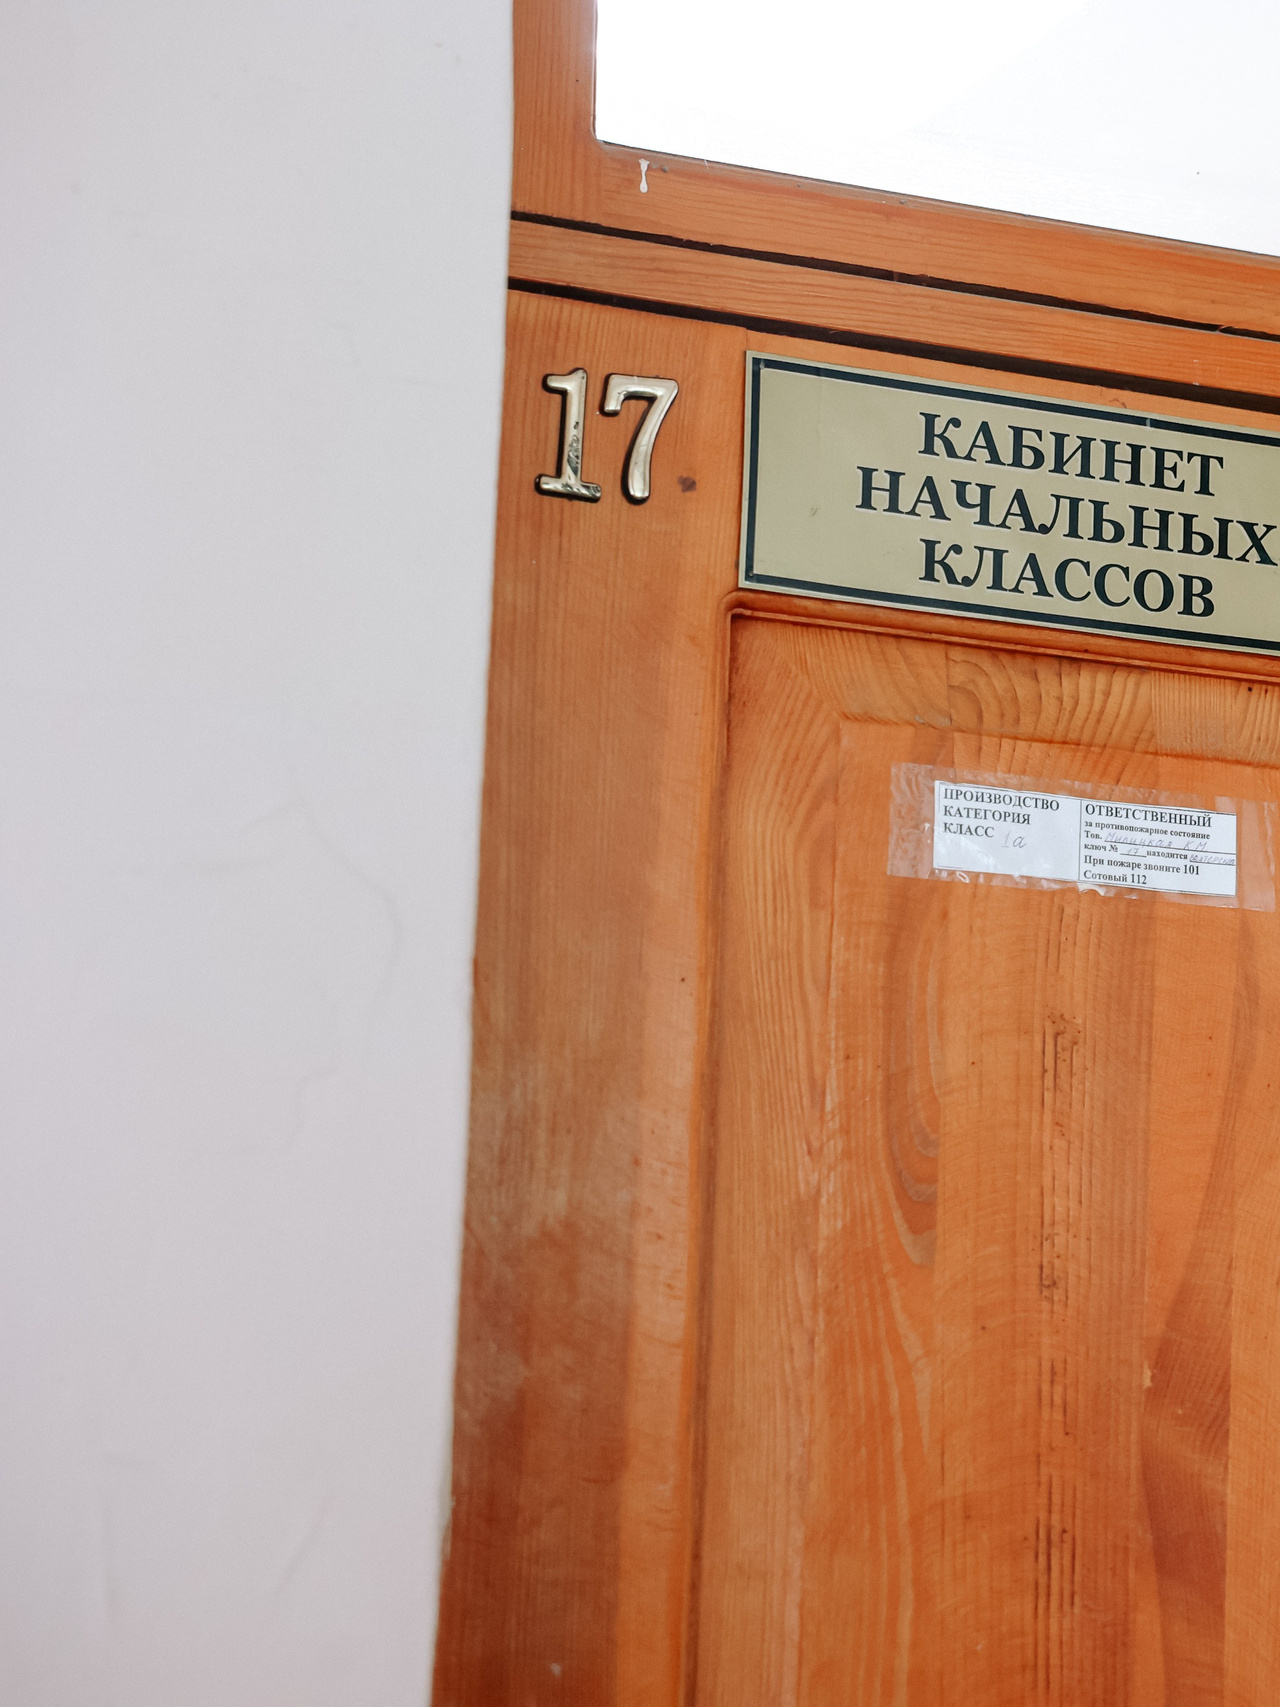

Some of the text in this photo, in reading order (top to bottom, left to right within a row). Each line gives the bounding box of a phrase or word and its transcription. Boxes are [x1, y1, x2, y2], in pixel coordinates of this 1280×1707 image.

[534, 367, 680, 505] 17
[918, 411, 1225, 497] КАБИНЕТ
[856, 466, 1279, 567] НАЧАЛЬНЫХ
[918, 538, 1216, 619] КЛАССОВ
[943, 788, 1060, 811] ПРОИЗВОДСТВО
[943, 805, 1031, 825] КАТЕГОРИЯ
[1085, 803, 1212, 827] ОТВЕТСТВЕННЫЙ
[943, 822, 995, 838] КЛАСС
[1084, 831, 1102, 840] Тов.
[1095, 821, 1168, 835] противопожарное
[1169, 830, 1211, 840] состояние
[1108, 844, 1118, 853] №
[1146, 850, 1188, 860] находится
[1084, 855, 1199, 875] При пожаре звоните 101
[1083, 870, 1147, 884] Сотовый 112
